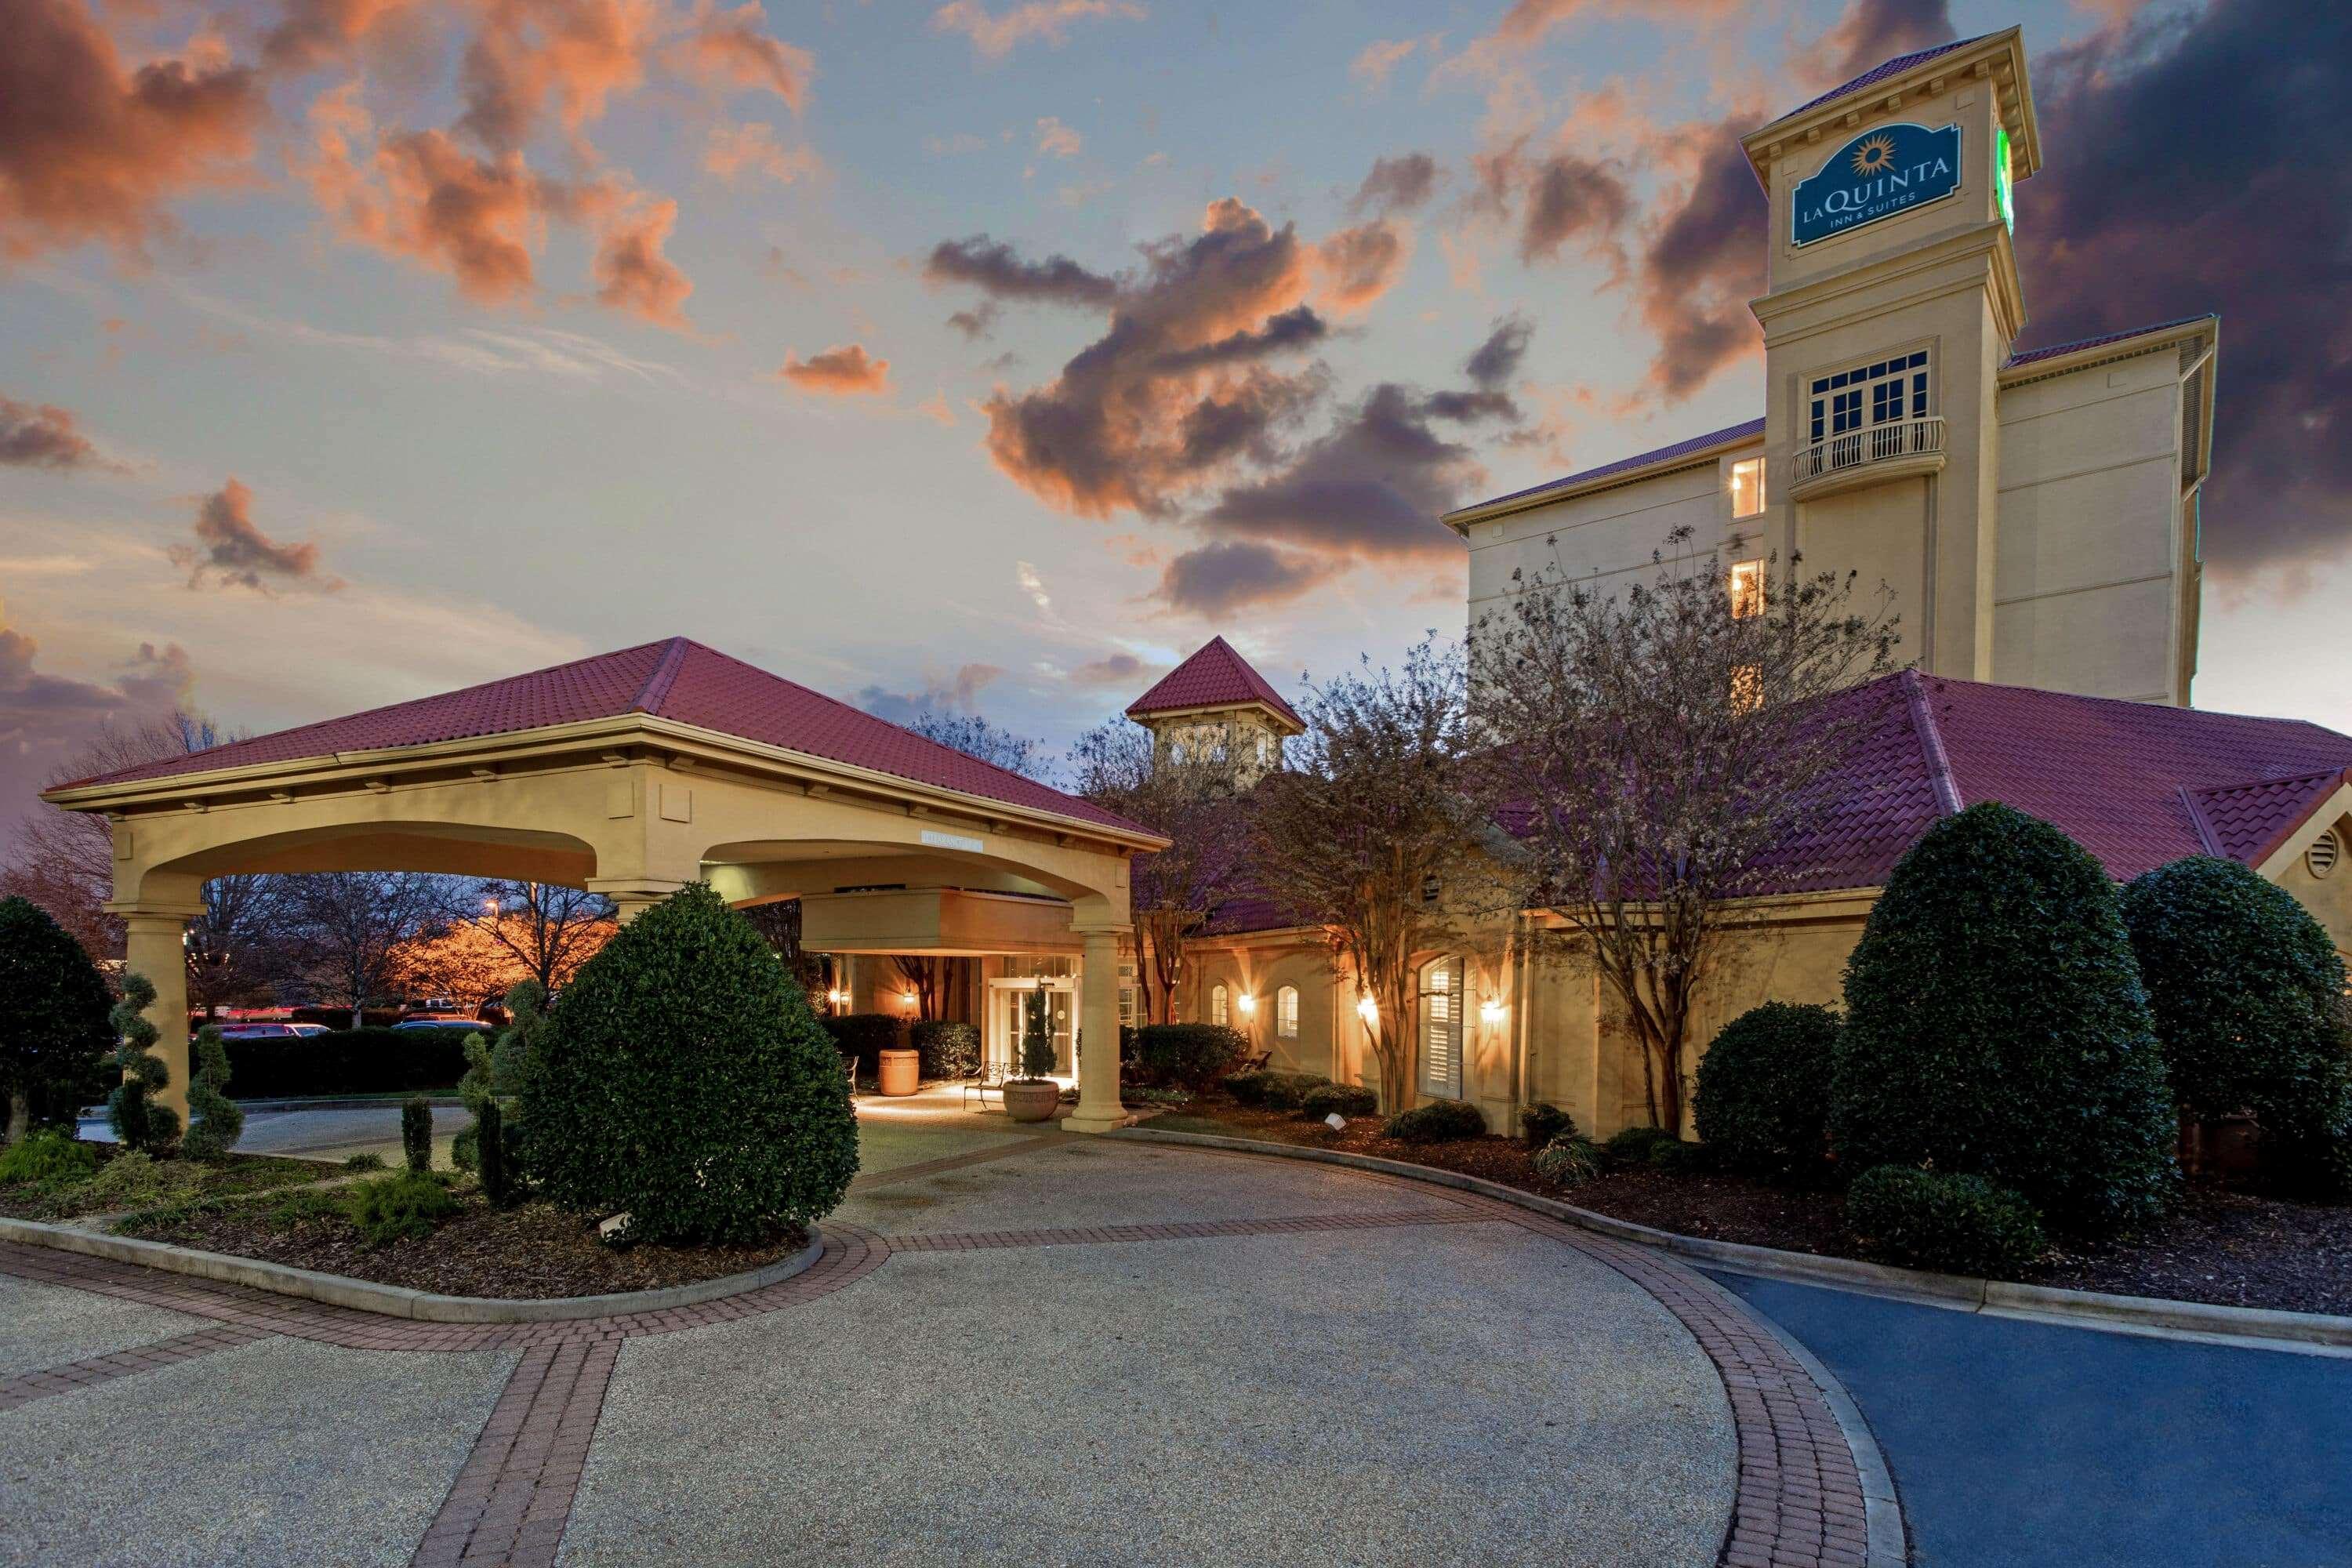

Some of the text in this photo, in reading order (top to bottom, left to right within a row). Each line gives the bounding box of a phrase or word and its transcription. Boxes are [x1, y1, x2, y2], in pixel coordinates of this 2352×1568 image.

[1803, 157, 1950, 223] LA QUINTA
[1830, 215, 1853, 228] INN
[1867, 192, 1915, 215] SUITES
